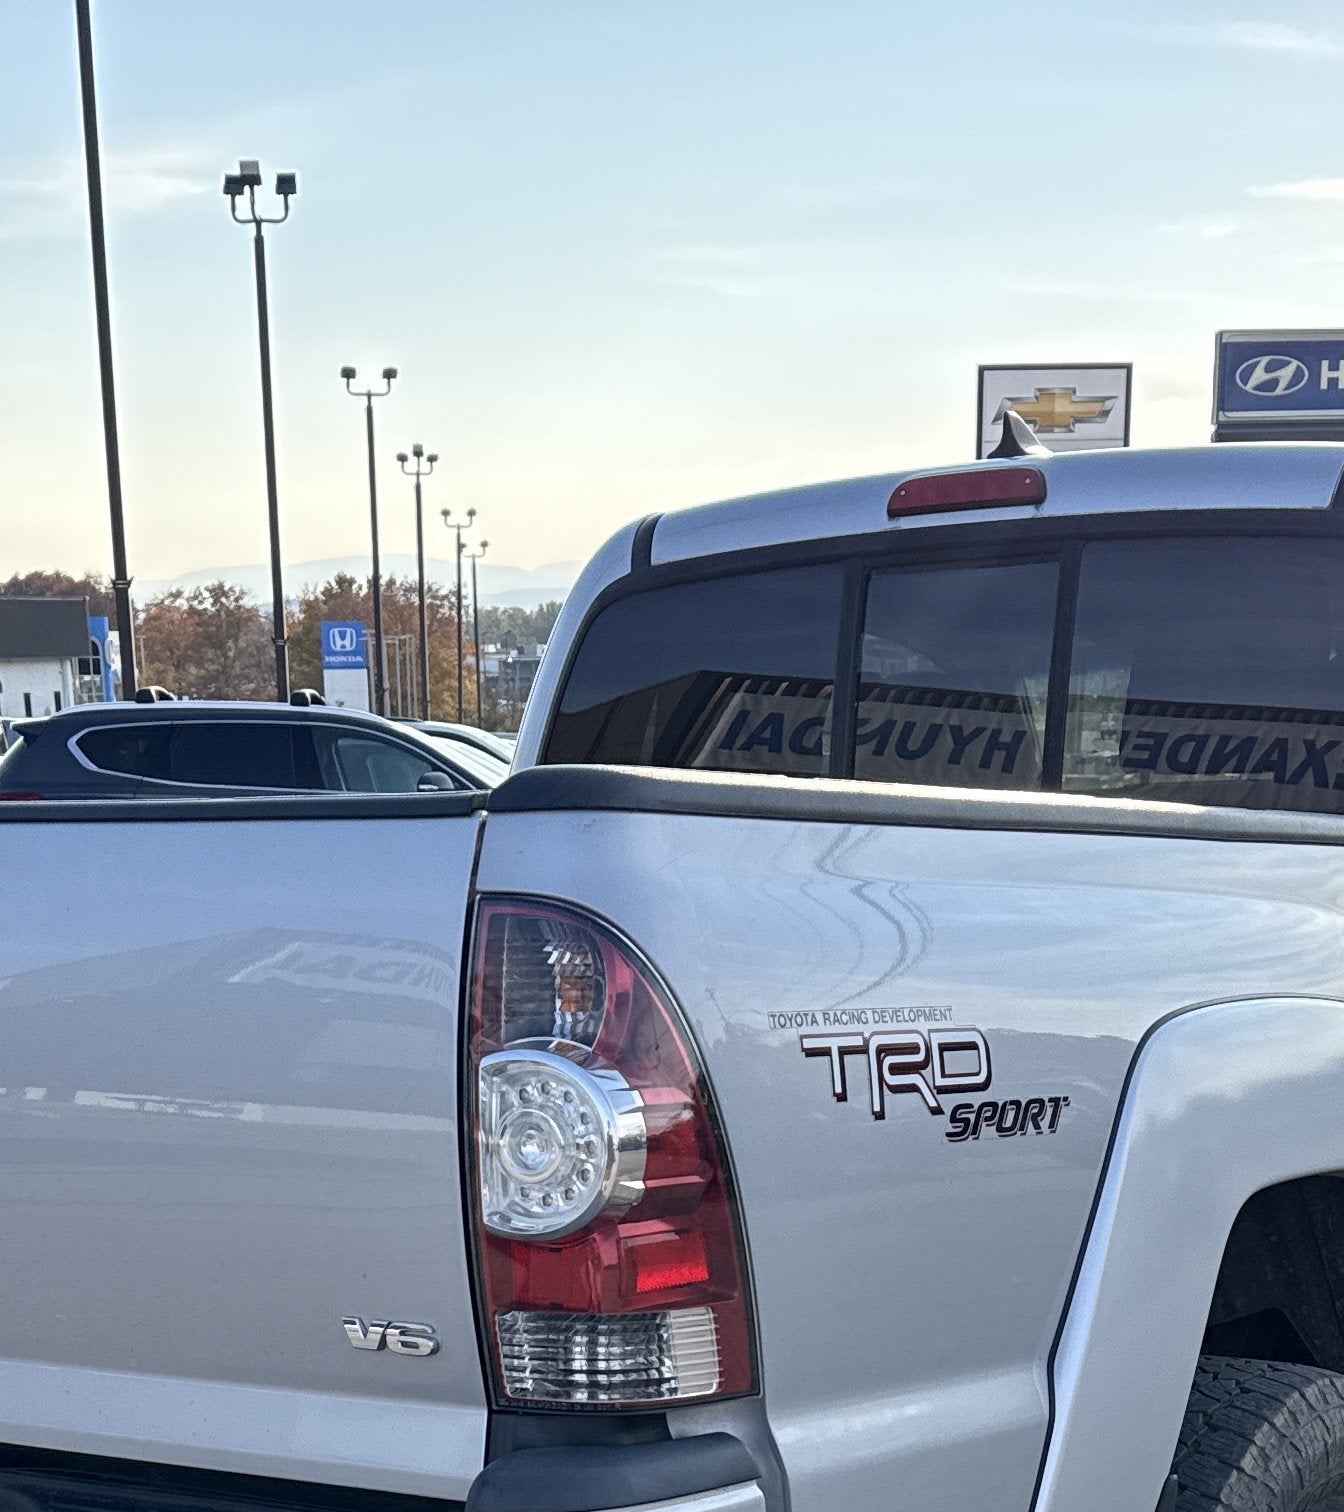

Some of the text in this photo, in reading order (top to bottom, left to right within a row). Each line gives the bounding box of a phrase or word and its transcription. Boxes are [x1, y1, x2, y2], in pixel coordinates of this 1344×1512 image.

[769, 1007, 953, 1028] TOYOTA RACING DEVELOPMENT
[799, 1028, 993, 1121] TRD
[944, 1096, 1072, 1143] SPORT
[341, 1316, 440, 1357] V6
